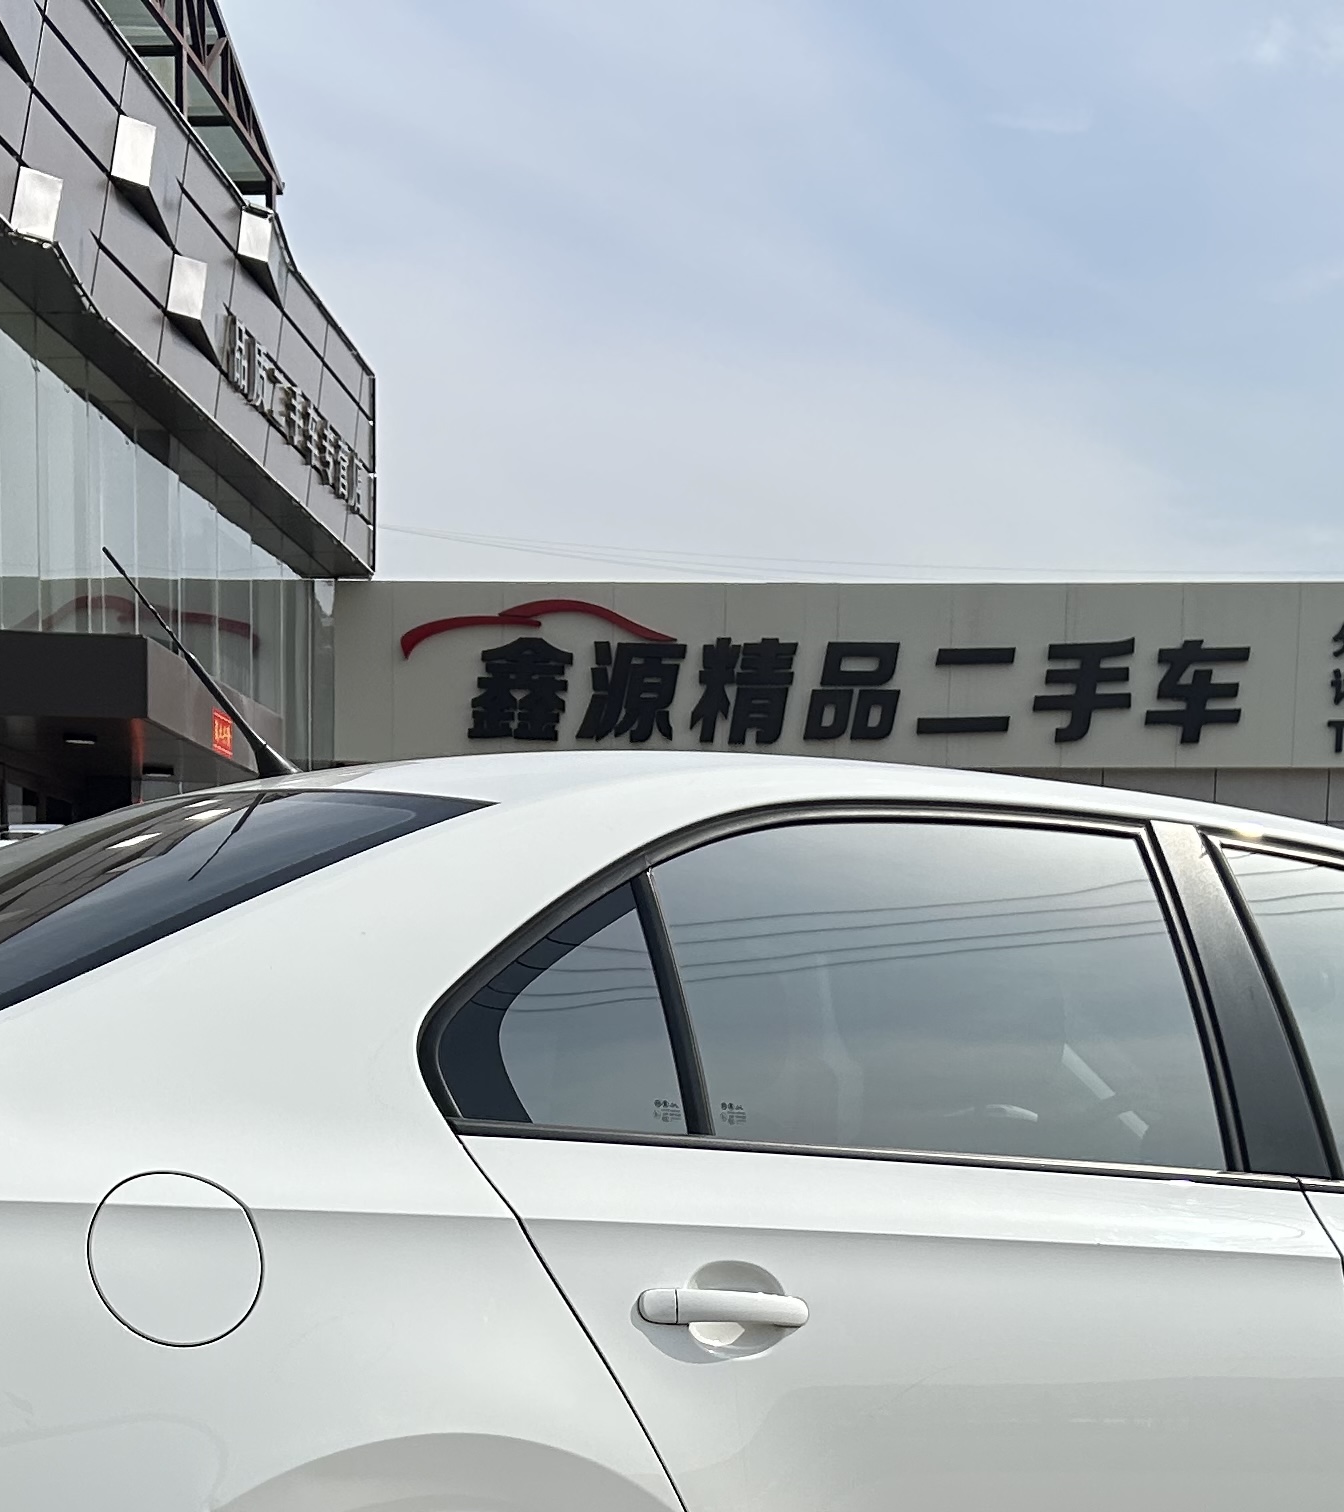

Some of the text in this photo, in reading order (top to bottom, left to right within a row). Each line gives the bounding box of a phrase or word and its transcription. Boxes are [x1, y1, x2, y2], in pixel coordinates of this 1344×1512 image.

[466, 636, 1252, 745] 鑫源精品二手车
